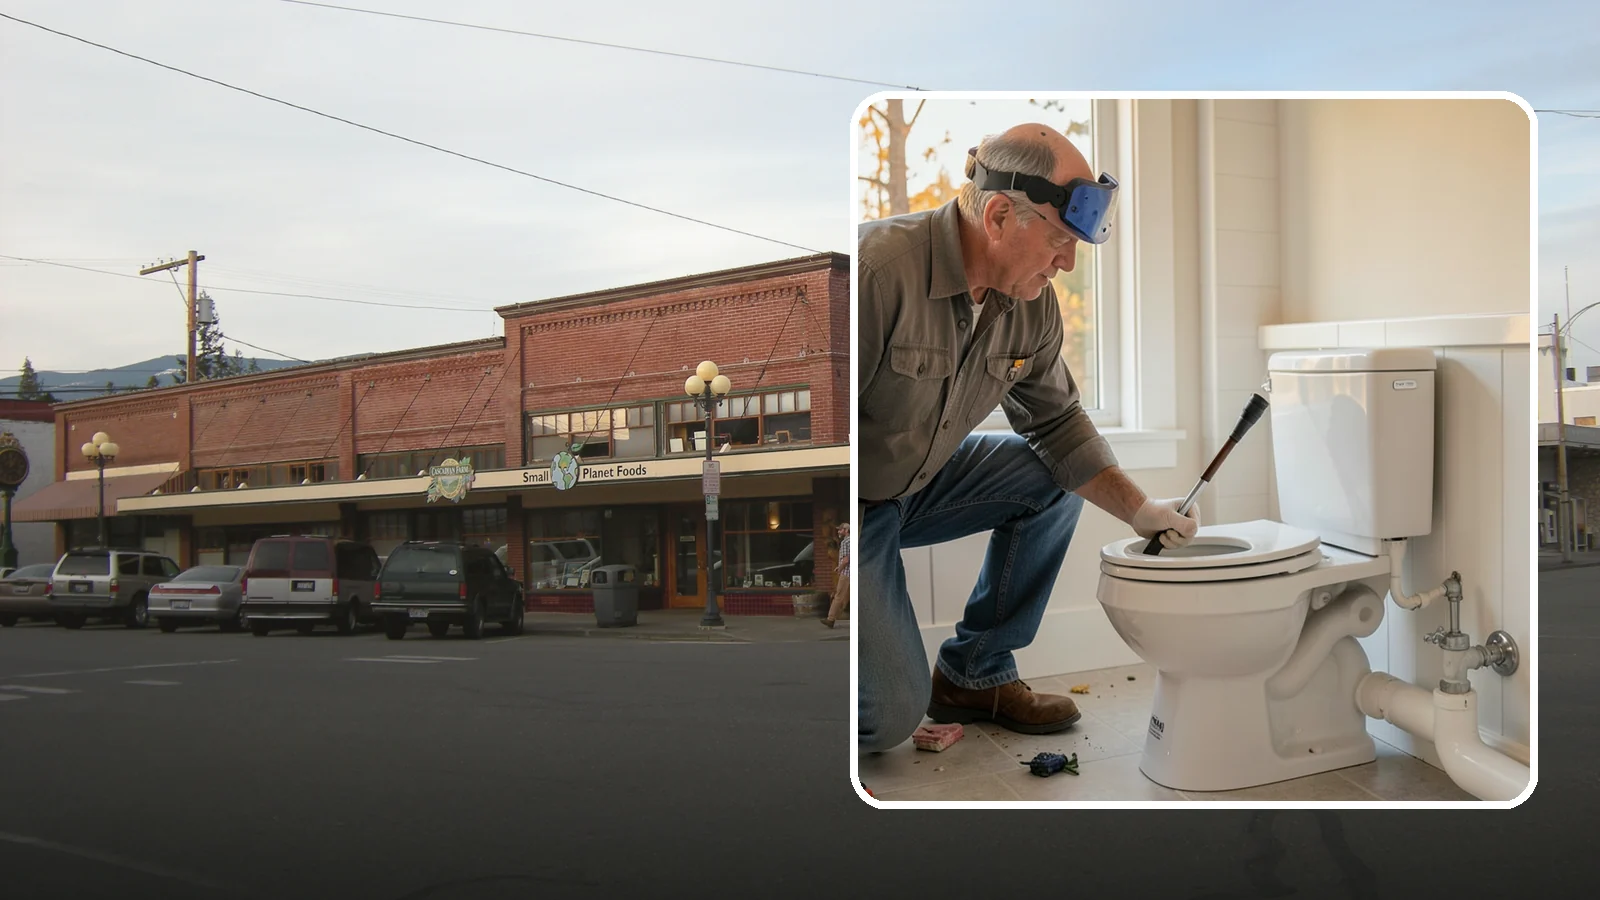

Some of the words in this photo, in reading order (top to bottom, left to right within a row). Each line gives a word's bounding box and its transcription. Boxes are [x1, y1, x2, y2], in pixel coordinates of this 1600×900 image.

[523, 470, 549, 483] Small
[582, 467, 614, 479] Planet
[617, 464, 647, 477] Foods
